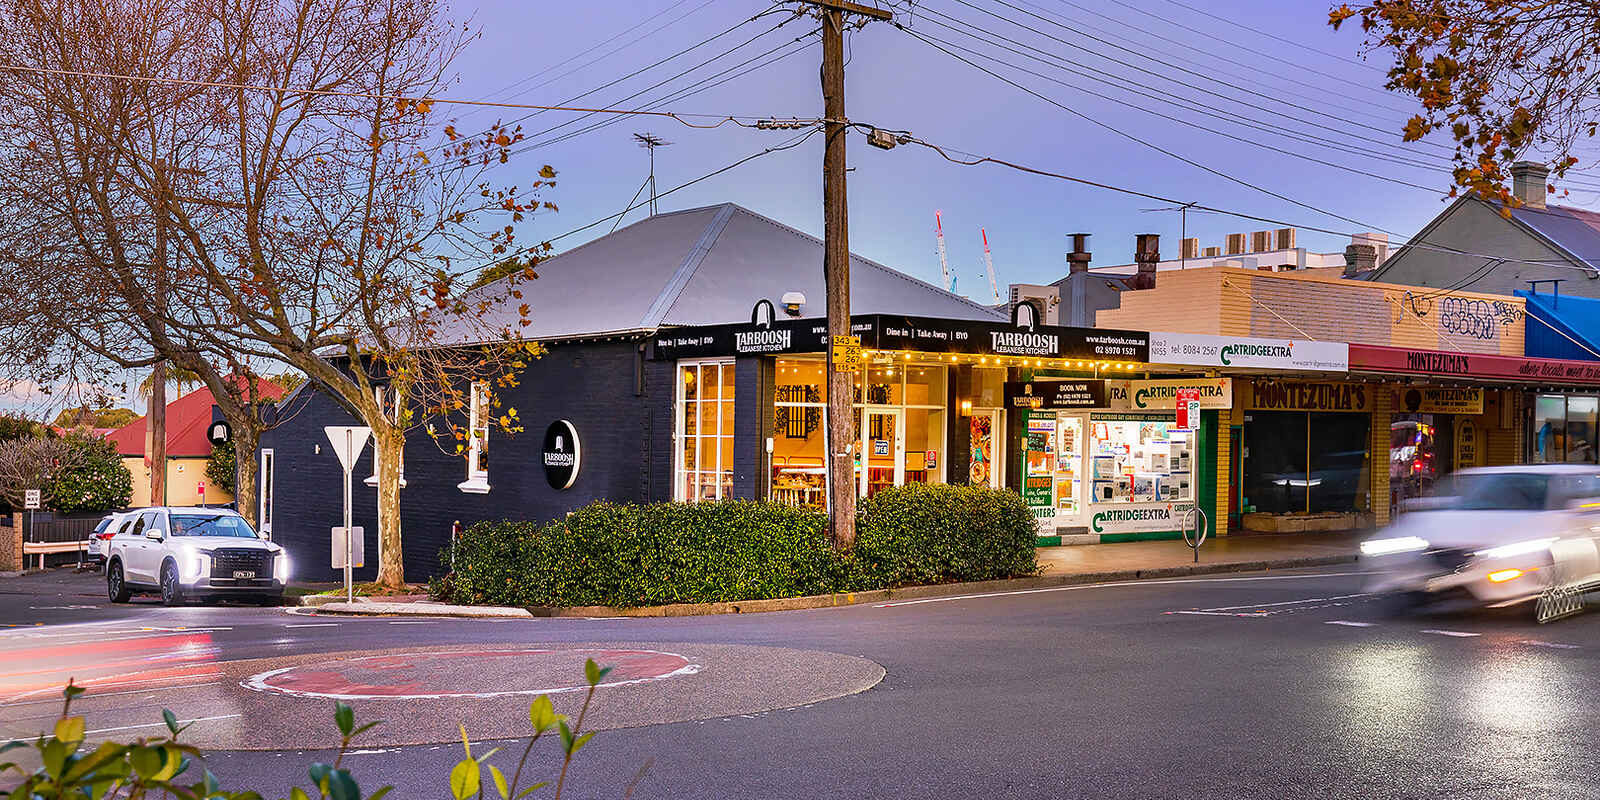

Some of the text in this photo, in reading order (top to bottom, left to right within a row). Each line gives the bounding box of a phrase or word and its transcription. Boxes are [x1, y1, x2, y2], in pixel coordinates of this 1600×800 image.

[886, 327, 900, 337] Dine
[917, 329, 931, 338] Take
[932, 330, 947, 340] Away
[955, 331, 968, 340] BYO
[734, 329, 791, 351] TARBOOSH
[835, 336, 850, 345] 343
[989, 331, 1058, 354] TARBOOSH
[1085, 336, 1146, 346] www.tarboosh.com.au
[739, 343, 783, 353] LEBANESE KITCHEN
[996, 345, 1049, 355] LEBANESE KITCHEN
[1095, 345, 1104, 354] 02
[1121, 347, 1136, 356] 1521
[1202, 345, 1218, 356] 2567
[845, 355, 860, 364] 267
[1407, 351, 1469, 373] MONTEZUMA'S
[1252, 381, 1366, 410] MONTEZUMA'S
[1424, 389, 1479, 401] MONTEZUMA'S
[1188, 402, 1199, 410] 2P
[544, 452, 573, 466] TARBOOSH
[1092, 508, 1170, 533] CARTRIDGEEXTRA
